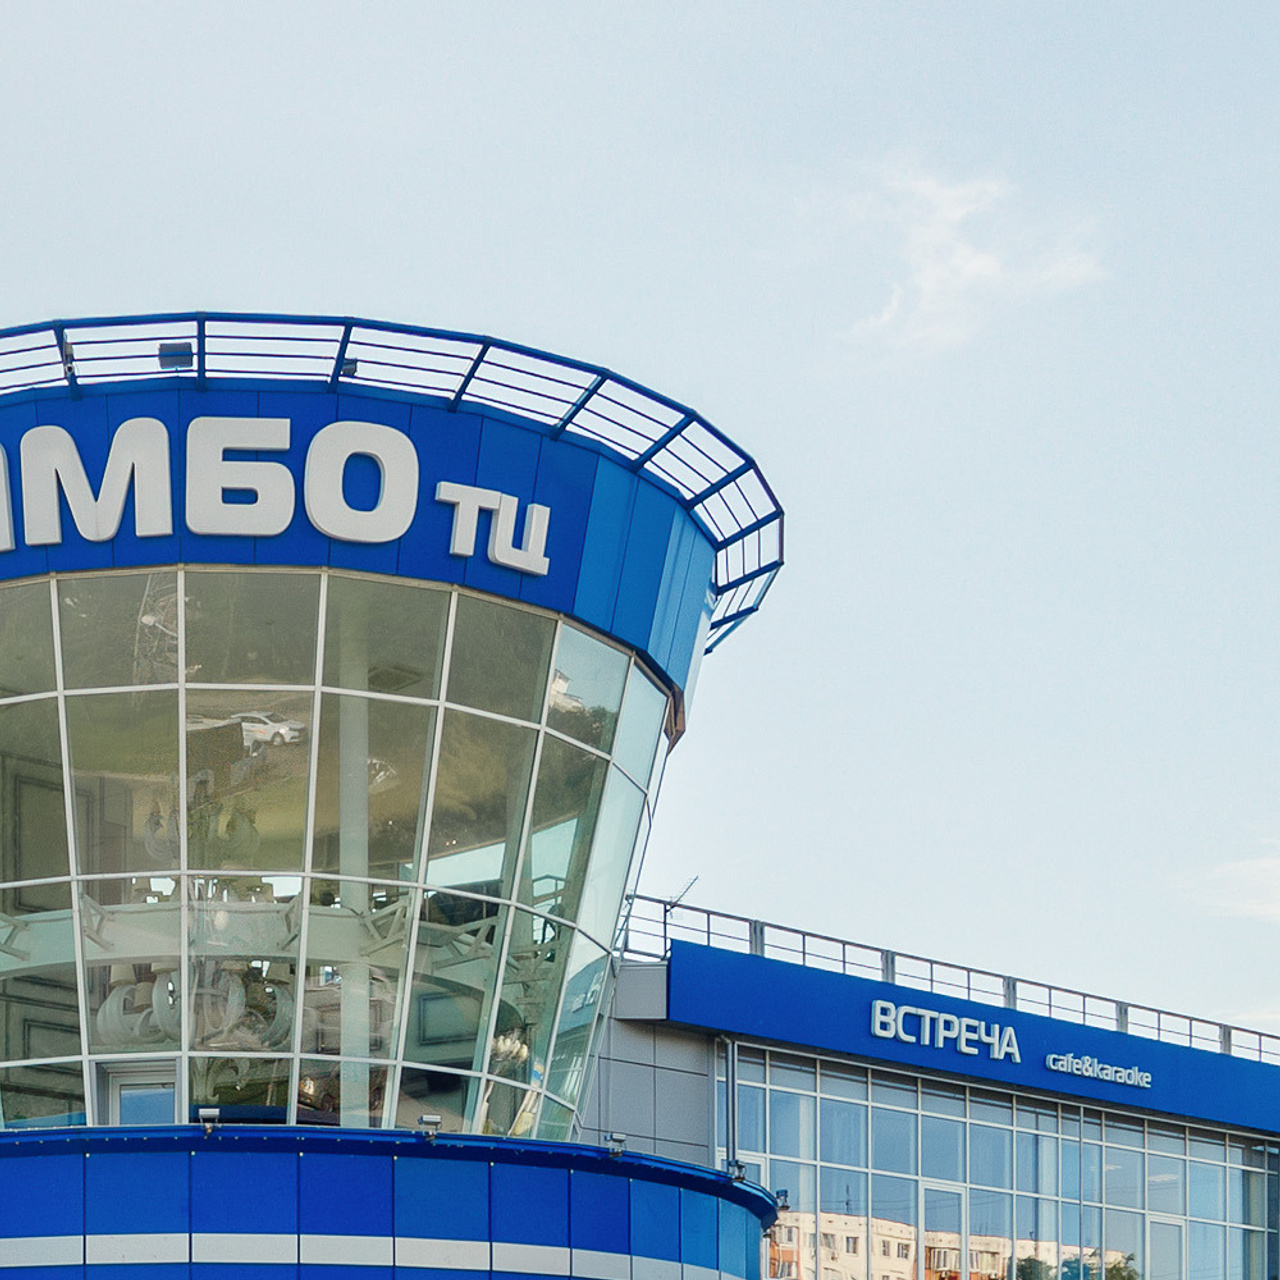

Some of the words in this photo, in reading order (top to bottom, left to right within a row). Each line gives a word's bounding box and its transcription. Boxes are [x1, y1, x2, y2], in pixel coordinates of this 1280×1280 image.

[435, 481, 550, 576] ТЦ
[870, 999, 1021, 1063] ВСТРЕЧА
[1046, 1052, 1152, 1088] cafe&karaoke
